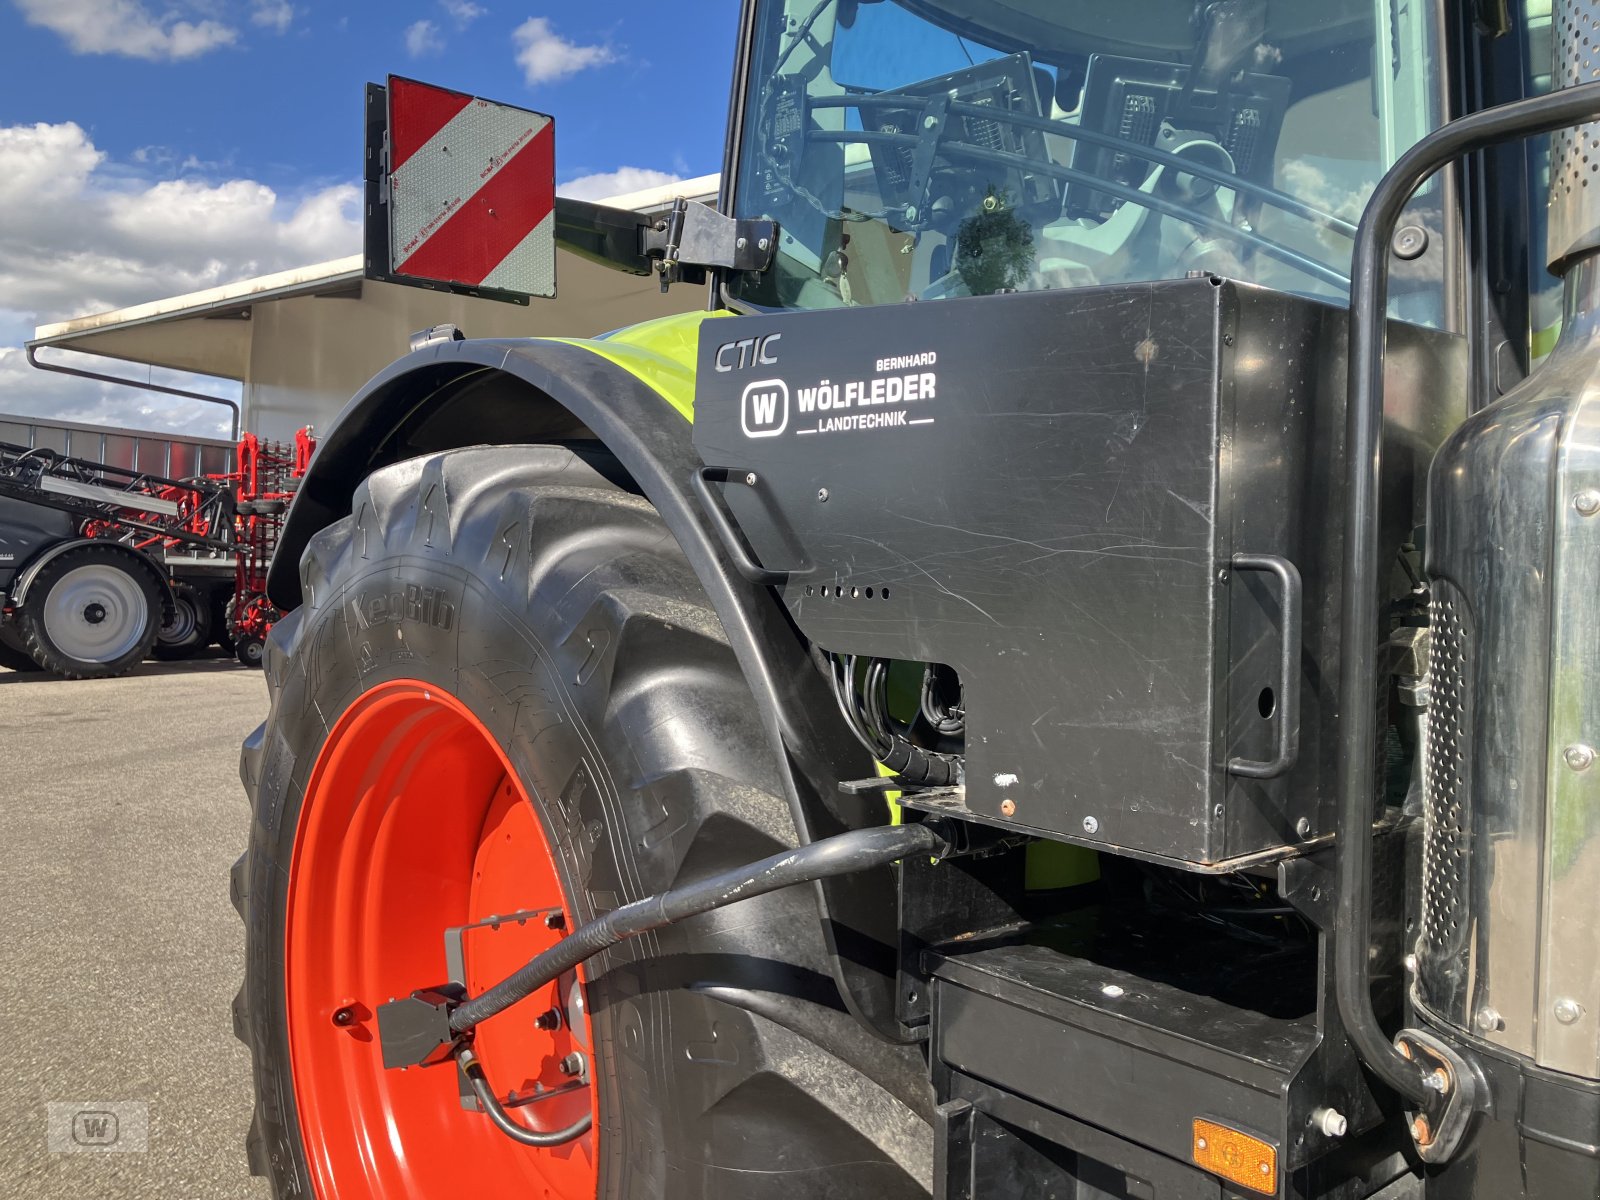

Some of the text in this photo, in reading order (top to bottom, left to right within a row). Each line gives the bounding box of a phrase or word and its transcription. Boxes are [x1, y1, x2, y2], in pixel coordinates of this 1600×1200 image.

[714, 332, 782, 373] CTIC
[876, 351, 937, 372] BERNHARD
[752, 372, 936, 425] W WÖLFLEDER
[818, 410, 907, 433] LANDTECHNIK
